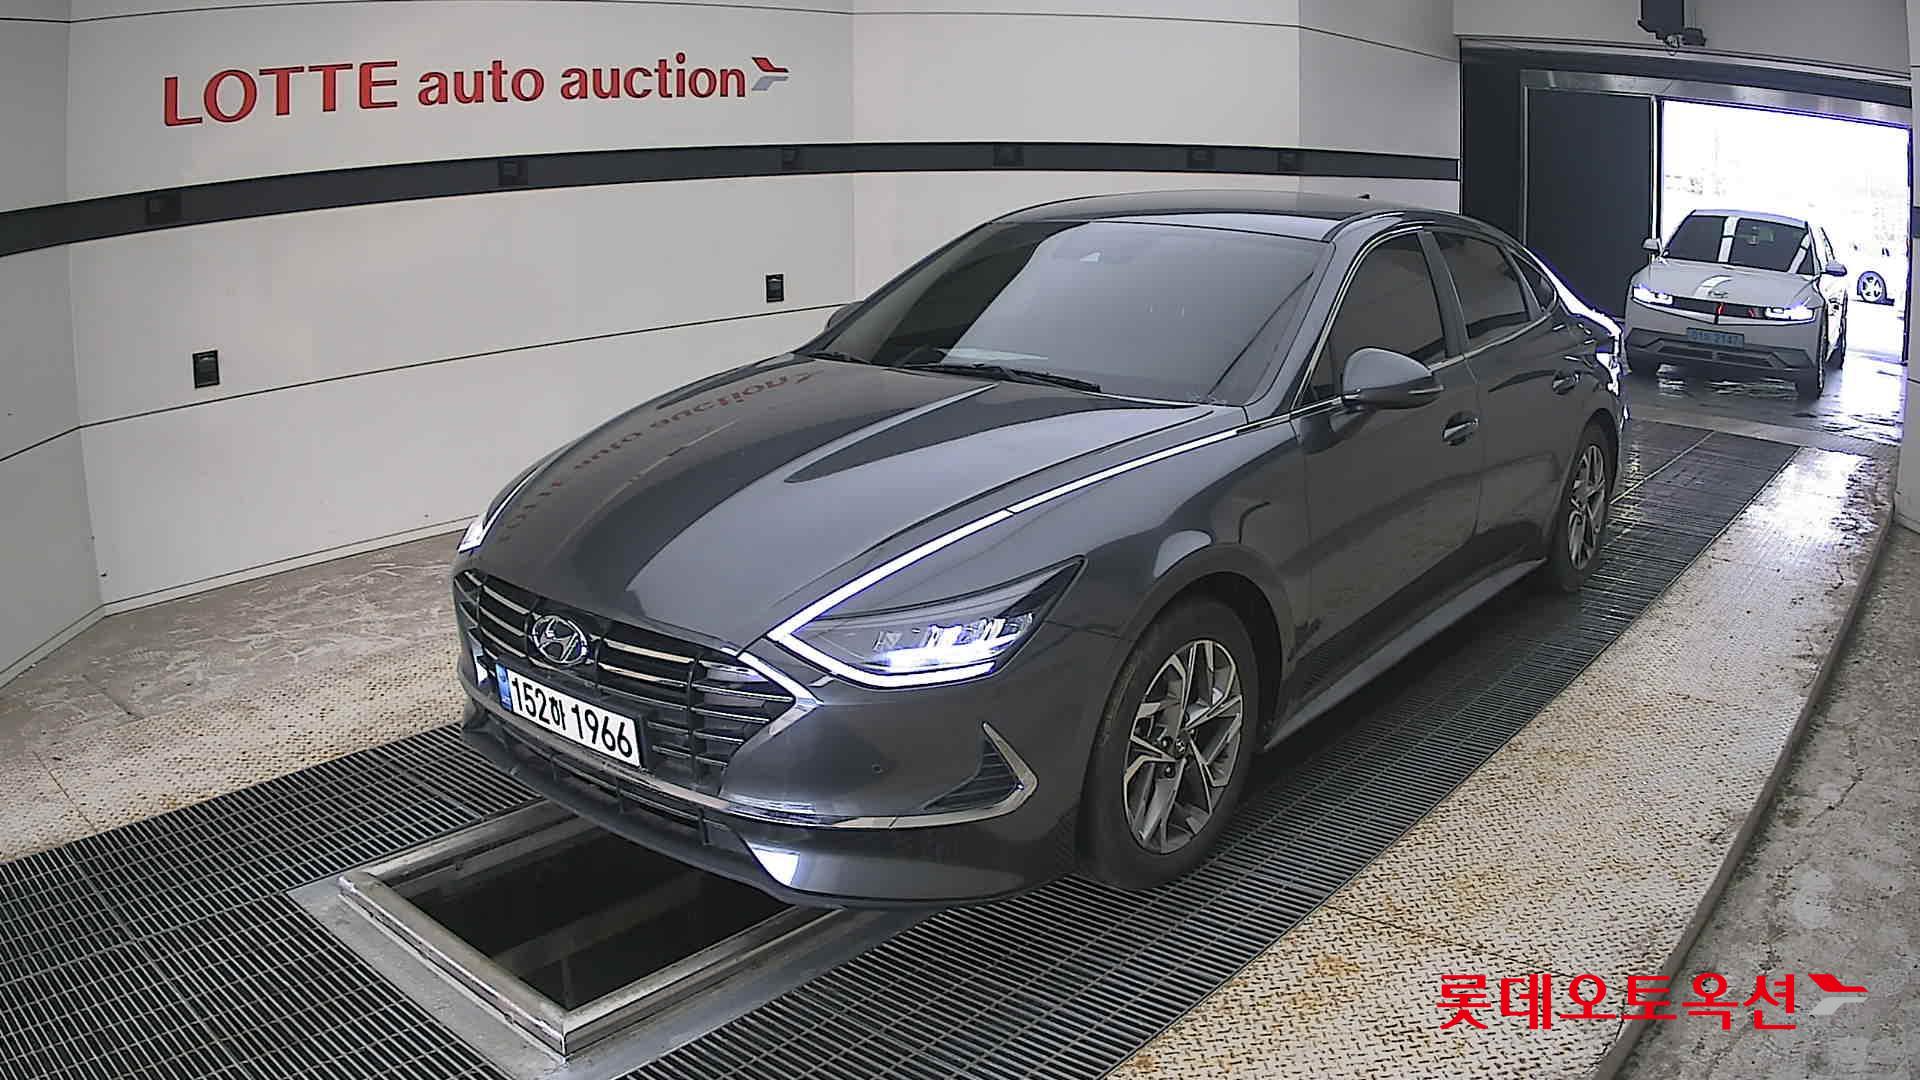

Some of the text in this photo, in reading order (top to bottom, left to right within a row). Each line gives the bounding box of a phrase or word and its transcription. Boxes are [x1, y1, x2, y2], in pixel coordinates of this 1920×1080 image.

[164, 52, 746, 127] LOTTE auto auction
[571, 703, 633, 758] 1966
